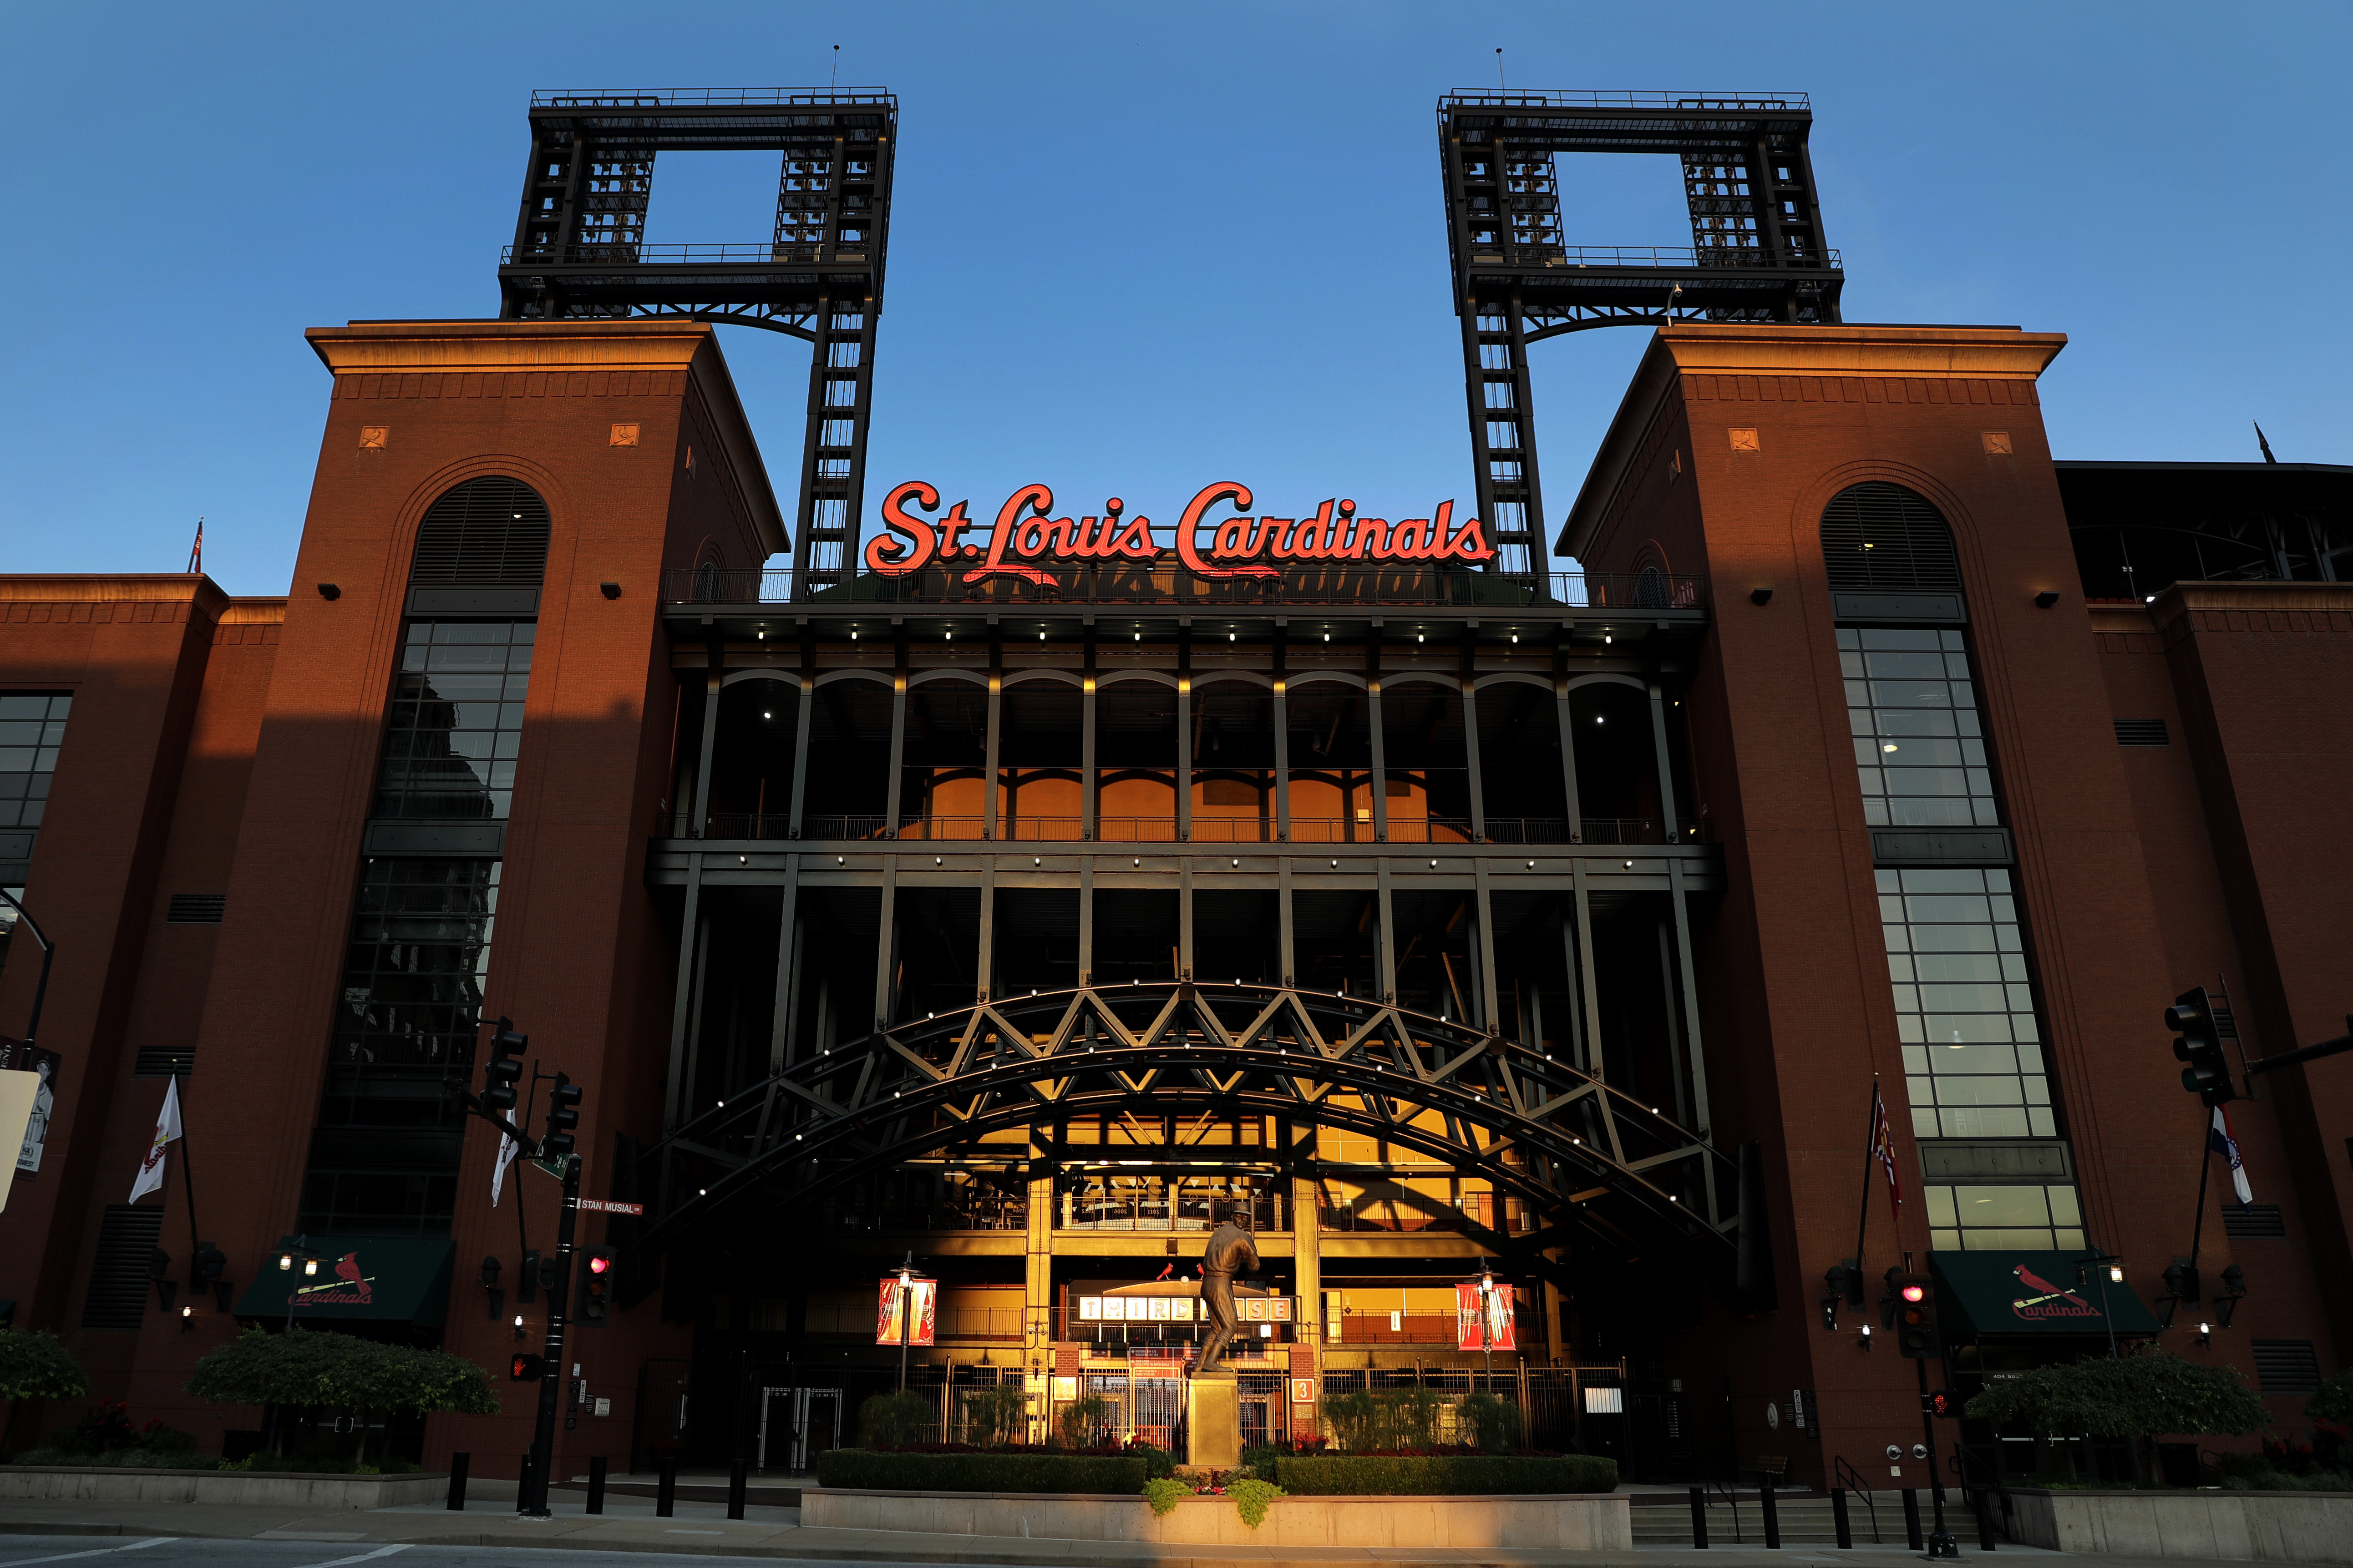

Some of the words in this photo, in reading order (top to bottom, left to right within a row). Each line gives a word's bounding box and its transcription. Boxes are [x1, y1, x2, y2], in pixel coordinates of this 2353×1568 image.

[864, 480, 980, 577] St.
[960, 483, 1165, 594] Louis
[1174, 479, 1501, 586] Cardinals
[582, 1200, 602, 1210] STAN
[605, 1203, 634, 1213] MUSIAL
[288, 1285, 372, 1306] Cardinals
[1086, 1301, 1189, 1318] THIRD
[2012, 1298, 2103, 1320] Cardinals
[1299, 1382, 1307, 1398] 3
